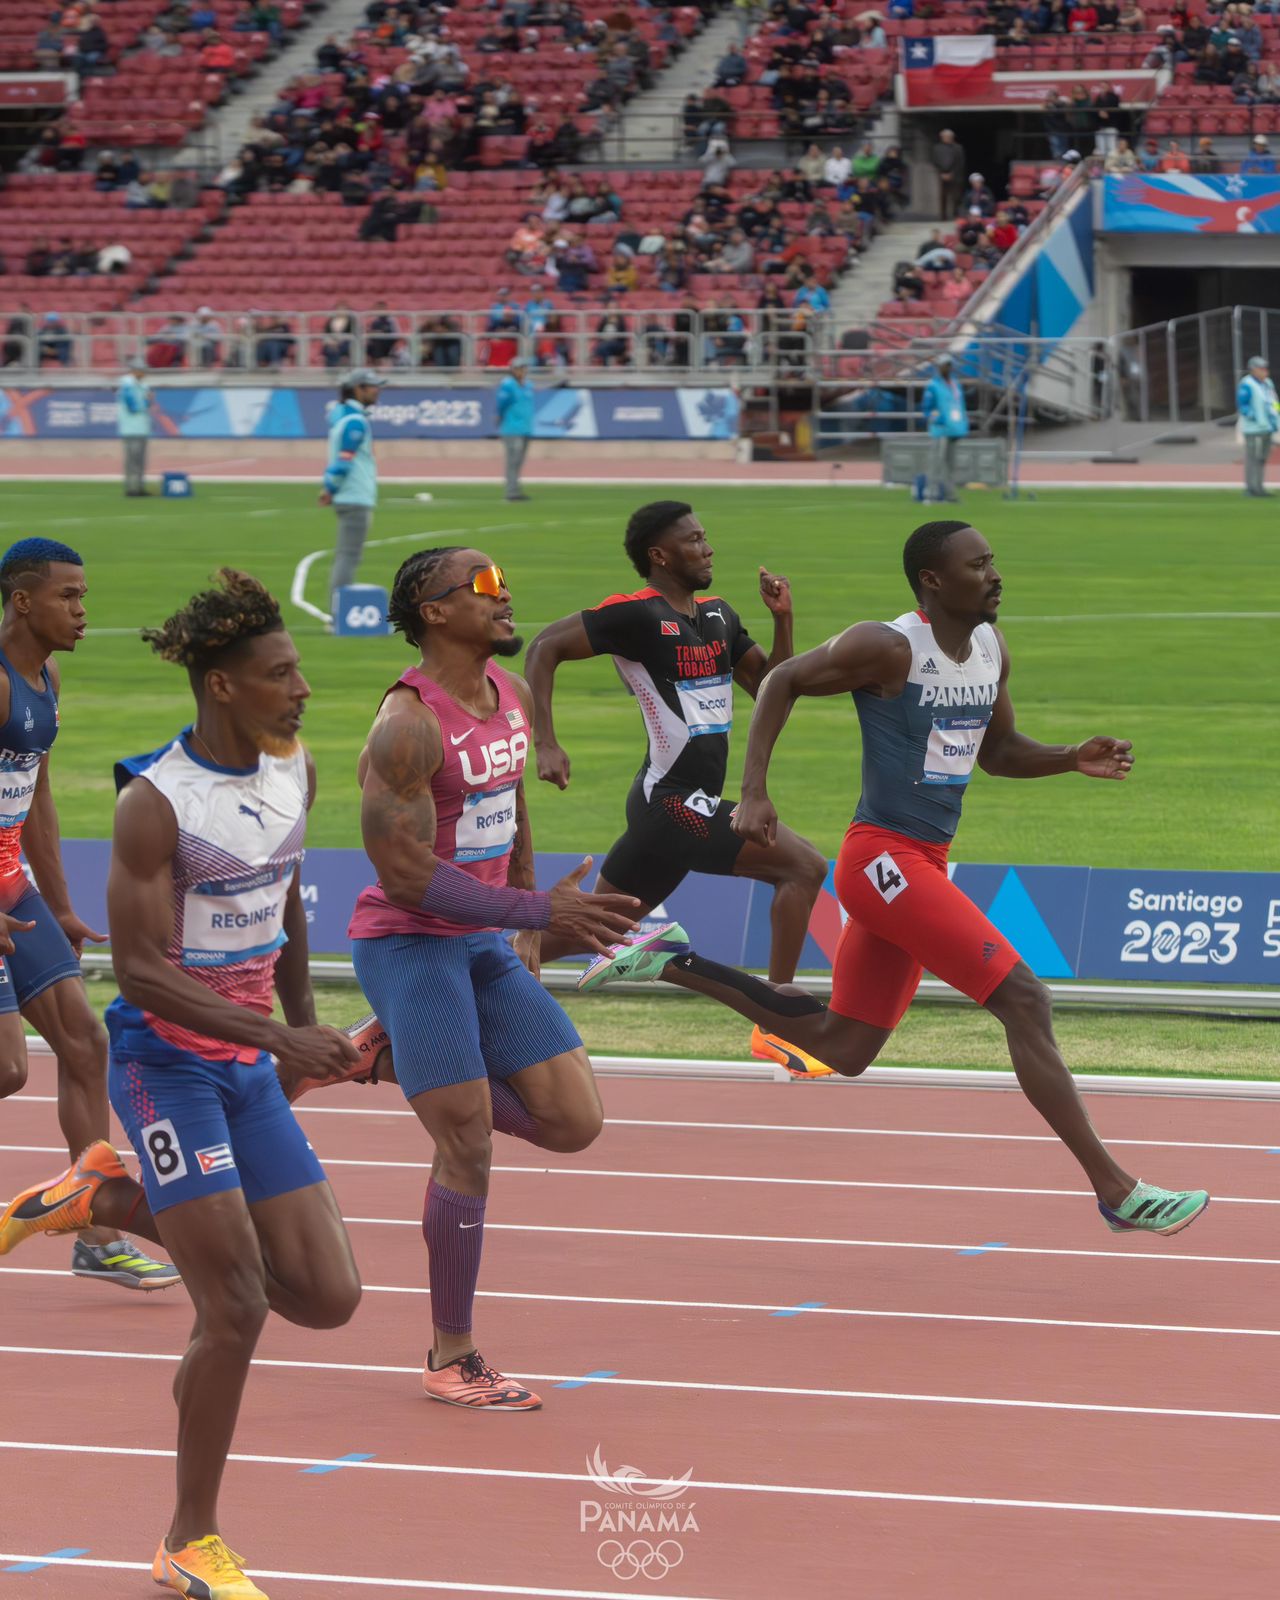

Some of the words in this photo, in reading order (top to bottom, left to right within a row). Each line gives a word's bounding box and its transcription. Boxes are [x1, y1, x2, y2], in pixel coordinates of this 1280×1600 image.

[345, 605, 381, 628] 60
[676, 659, 717, 677] TOBAGO
[920, 667, 940, 675] adidas
[458, 731, 528, 786] USA
[692, 796, 717, 814] 2
[876, 861, 901, 894] 4
[1127, 887, 1243, 918] Santiago
[1120, 919, 1241, 965] 2023
[148, 1130, 179, 1176] 8
